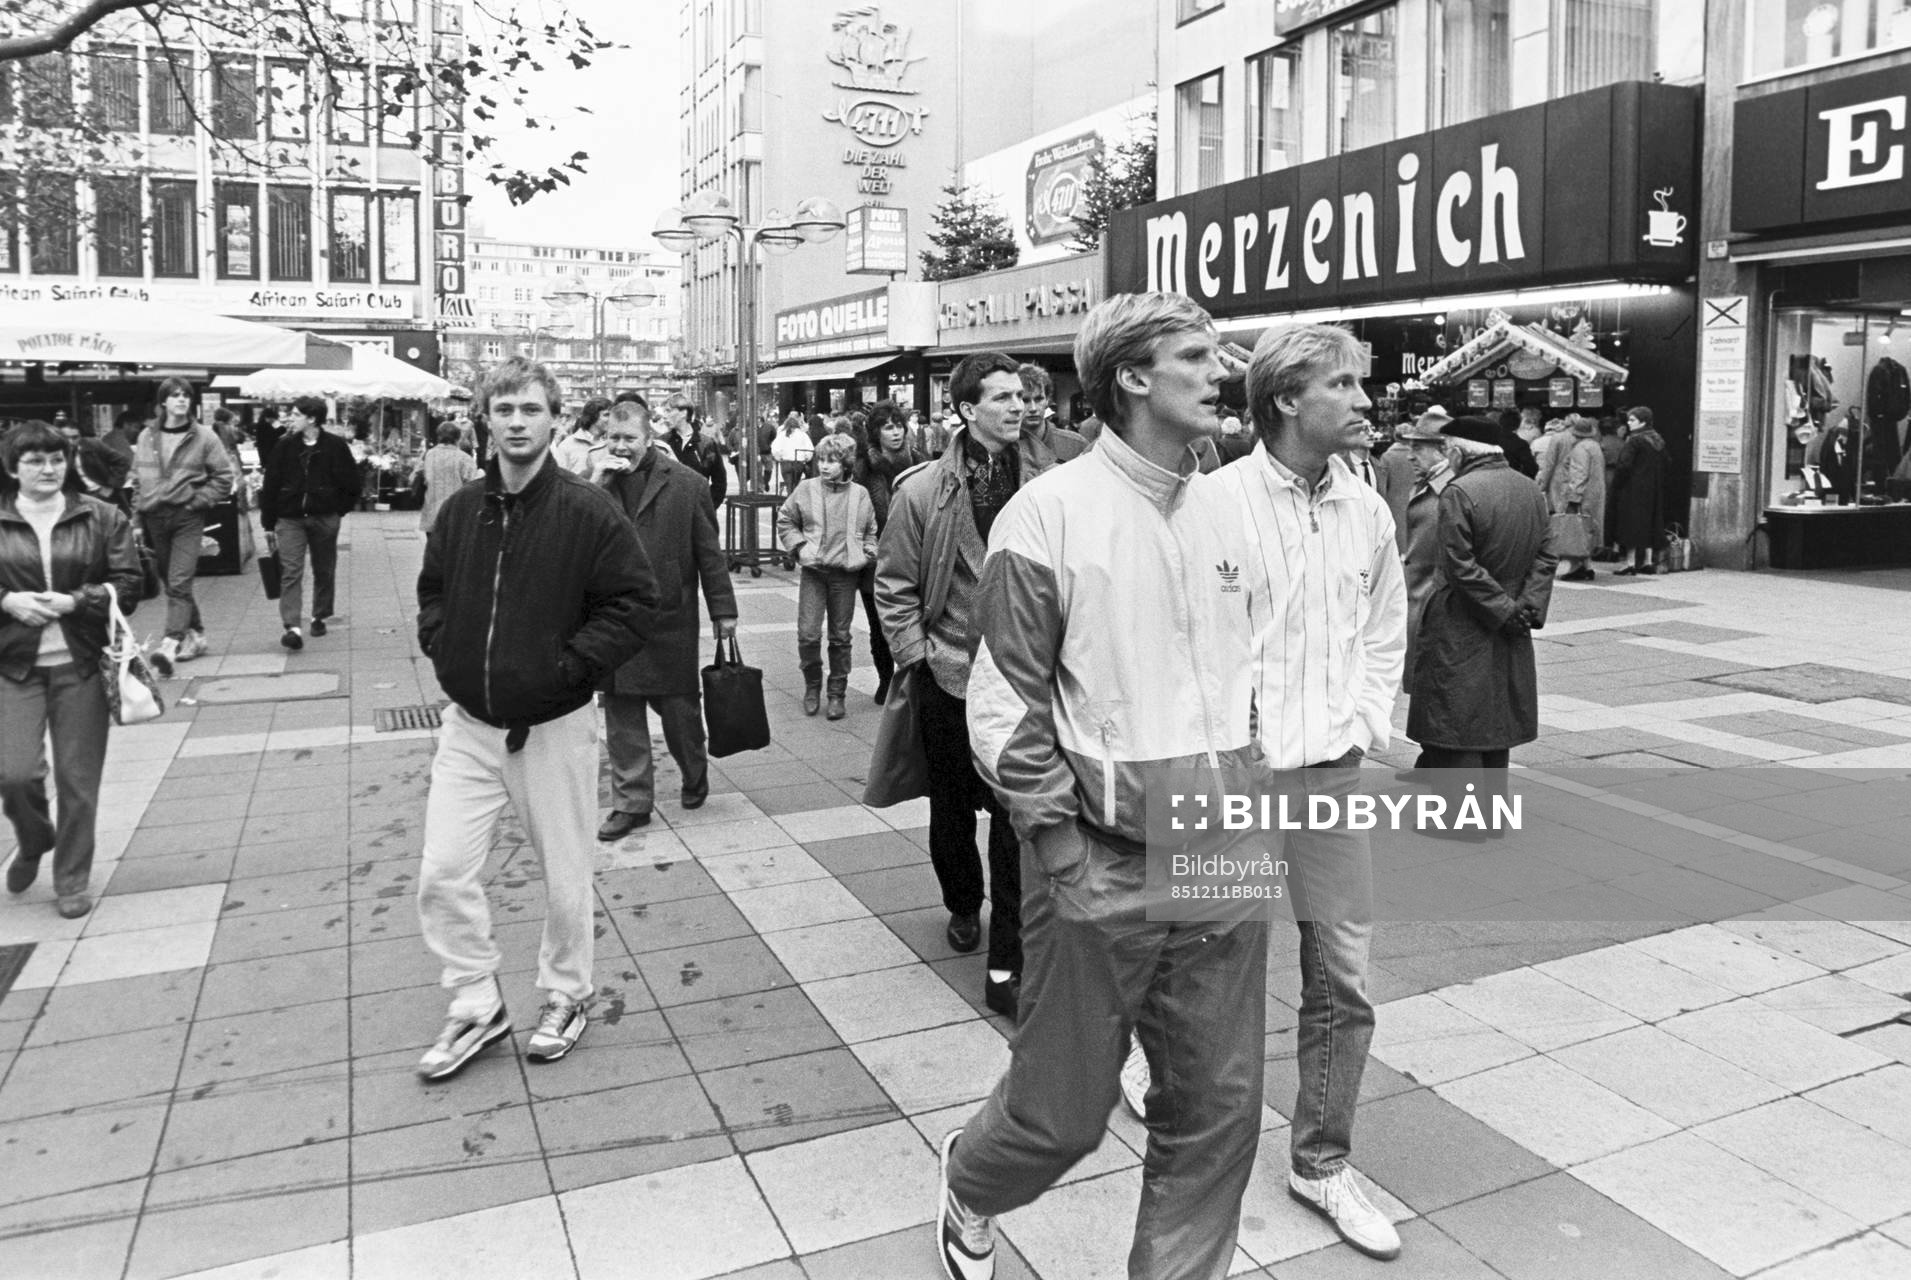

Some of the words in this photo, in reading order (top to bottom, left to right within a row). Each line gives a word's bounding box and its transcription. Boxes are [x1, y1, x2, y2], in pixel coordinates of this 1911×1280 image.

[849, 106, 901, 137] 4711
[1816, 95, 1906, 190] E
[844, 150, 869, 165] DIE
[870, 151, 906, 168] ZAHL
[862, 167, 888, 180] DER
[858, 181, 892, 195] WELT
[249, 291, 307, 307] African
[316, 292, 361, 308] Safari
[366, 293, 402, 309] Club
[778, 310, 818, 342] FOTO
[821, 296, 888, 335] QUELLE
